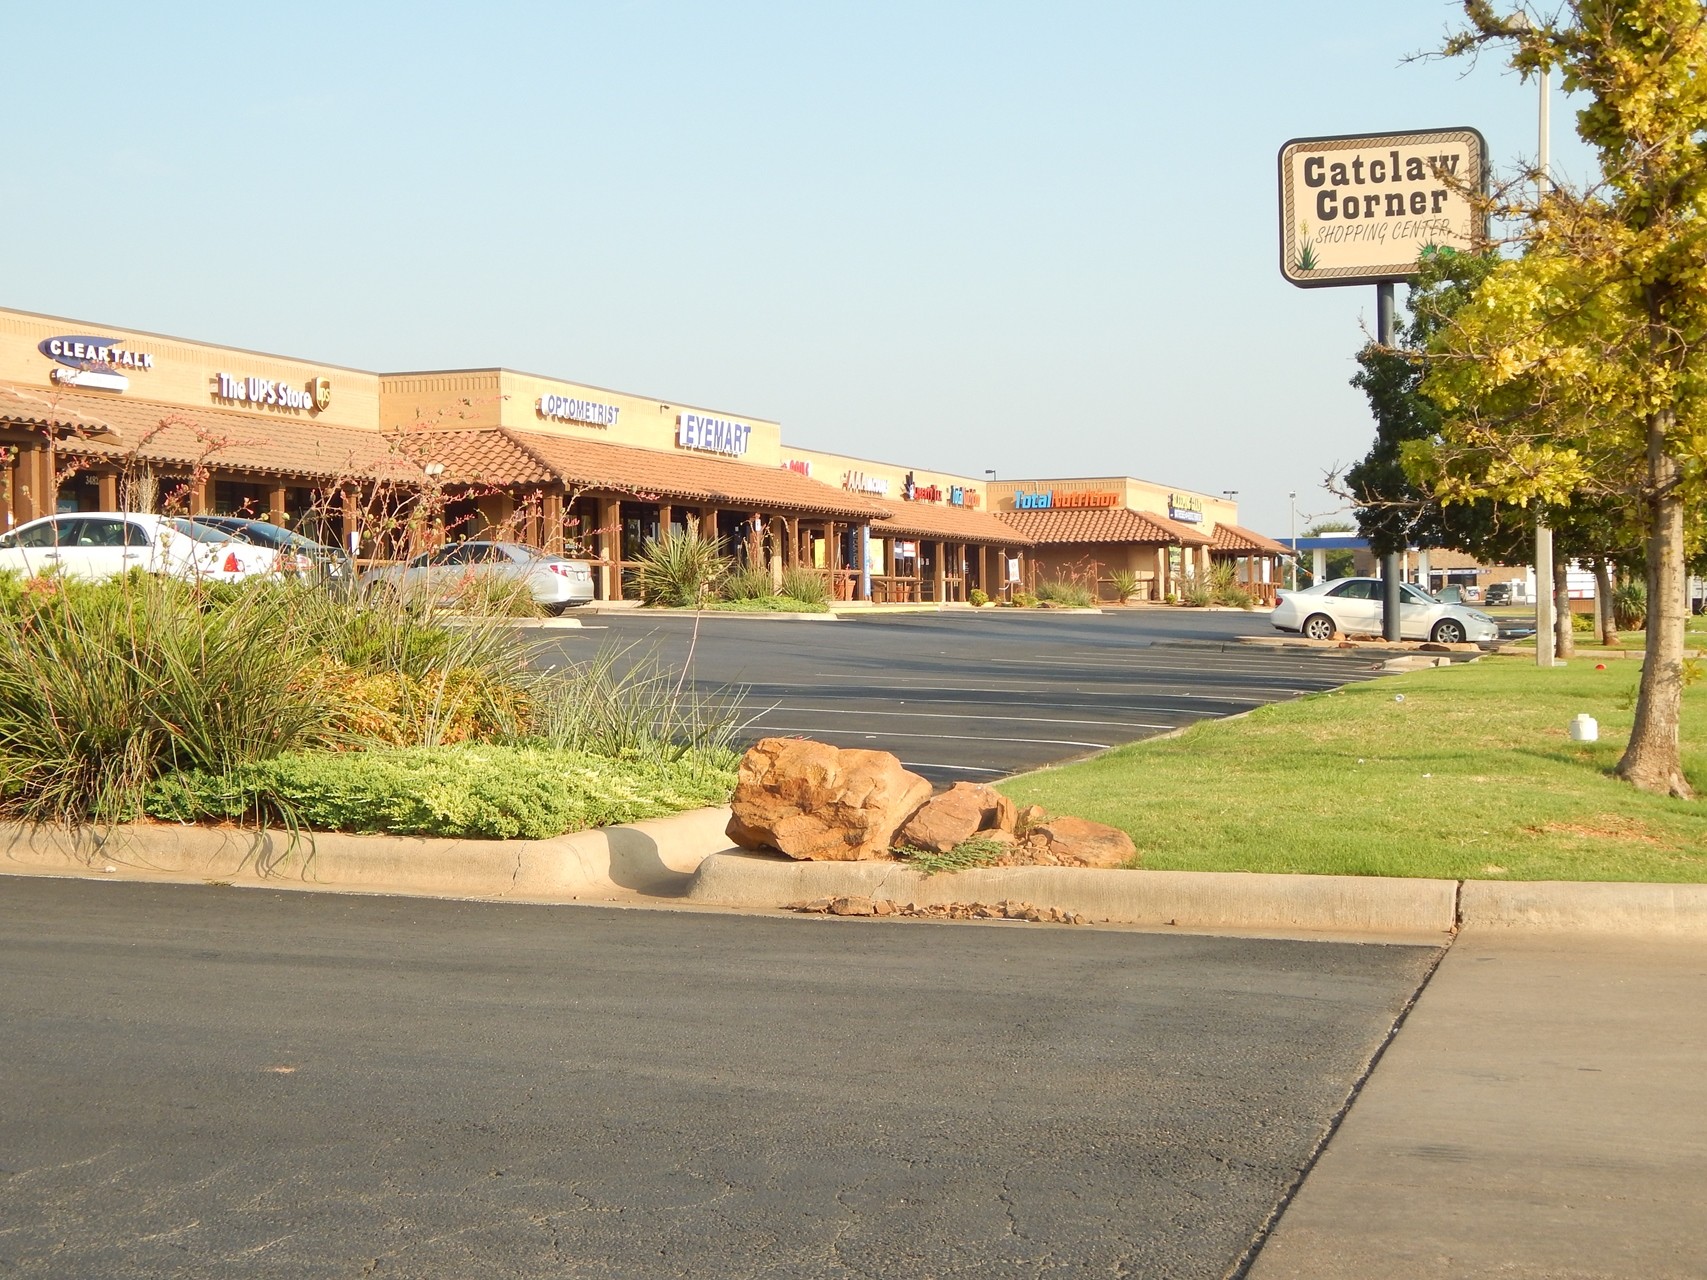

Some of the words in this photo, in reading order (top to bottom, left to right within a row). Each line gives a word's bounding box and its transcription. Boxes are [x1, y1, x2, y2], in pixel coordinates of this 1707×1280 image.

[1304, 151, 1460, 188] Catclaw
[1316, 189, 1448, 221] Corner
[1315, 222, 1388, 245] SHOPPING
[1393, 218, 1451, 240] CENTER
[220, 373, 246, 400] The
[248, 376, 277, 404] UPS
[278, 382, 312, 410] Store
[547, 395, 620, 425] OPTOMETRIST
[686, 415, 752, 454] EYEMART
